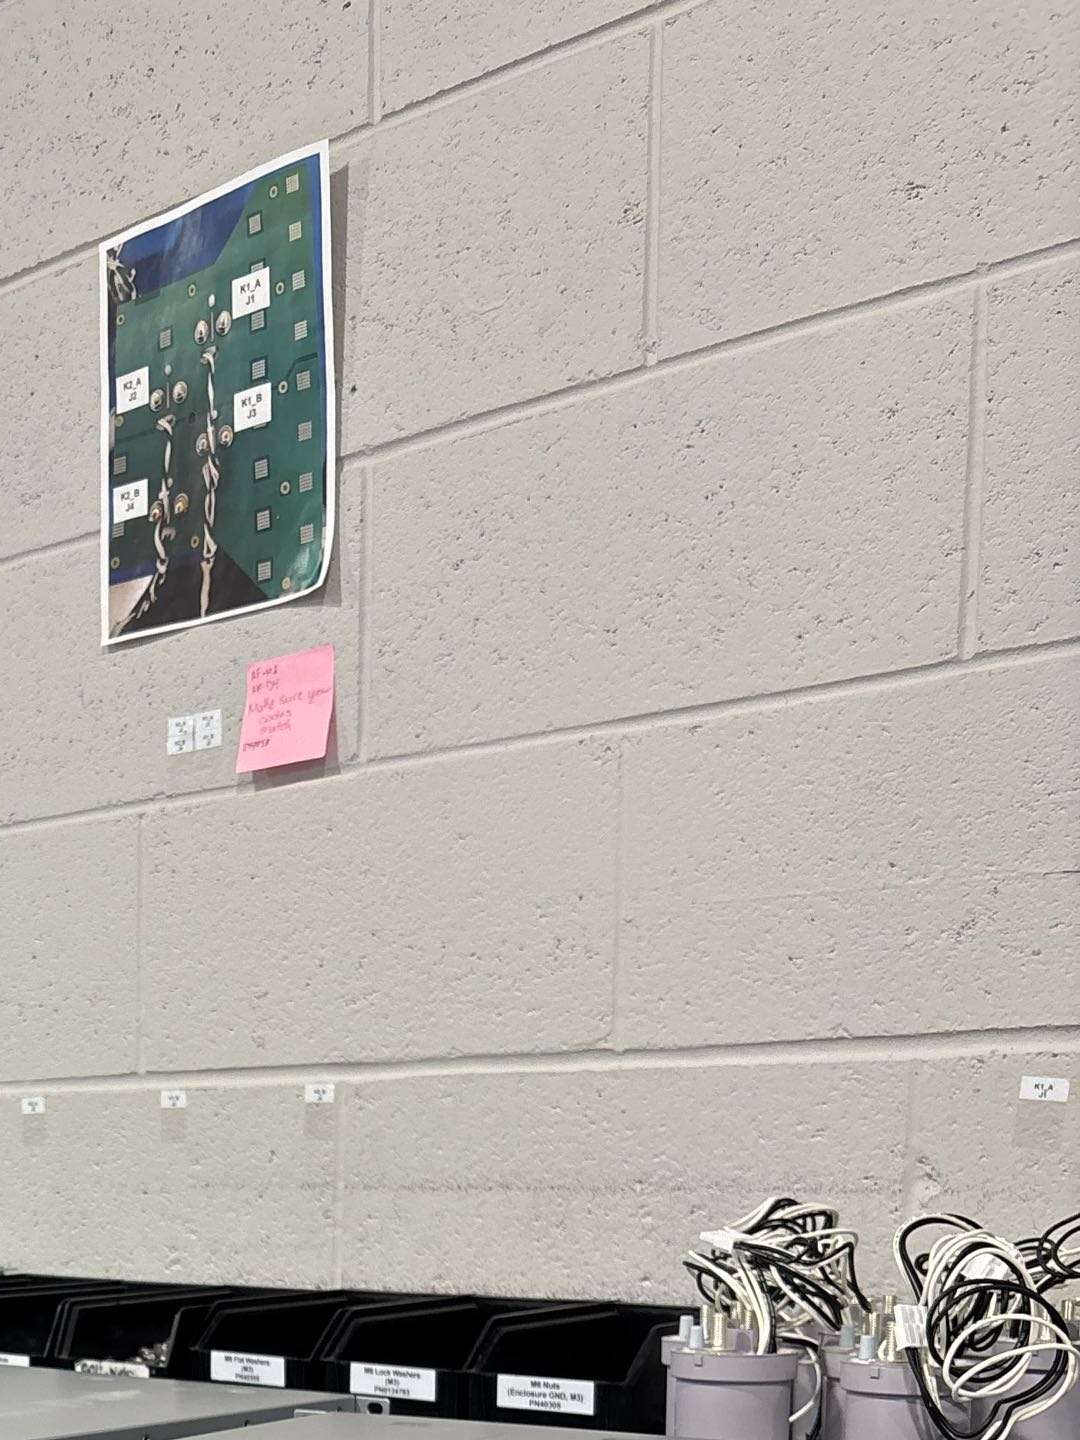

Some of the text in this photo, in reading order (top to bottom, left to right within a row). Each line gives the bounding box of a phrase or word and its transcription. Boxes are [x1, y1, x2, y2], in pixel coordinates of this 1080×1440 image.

[240, 279, 261, 294] K1_A
[246, 294, 255, 306] J1
[123, 377, 142, 391] K2_A
[129, 392, 137, 402] J2
[241, 393, 263, 408] K1_B
[247, 408, 257, 419] J3
[121, 488, 140, 502] K2_B
[246, 1357, 270, 1367] Washers
[375, 1368, 390, 1376] Lock
[392, 1369, 421, 1380] Washers
[543, 1381, 560, 1390] Nuts
[508, 1386, 547, 1399] (Enclosure
[549, 1391, 568, 1401] GND,
